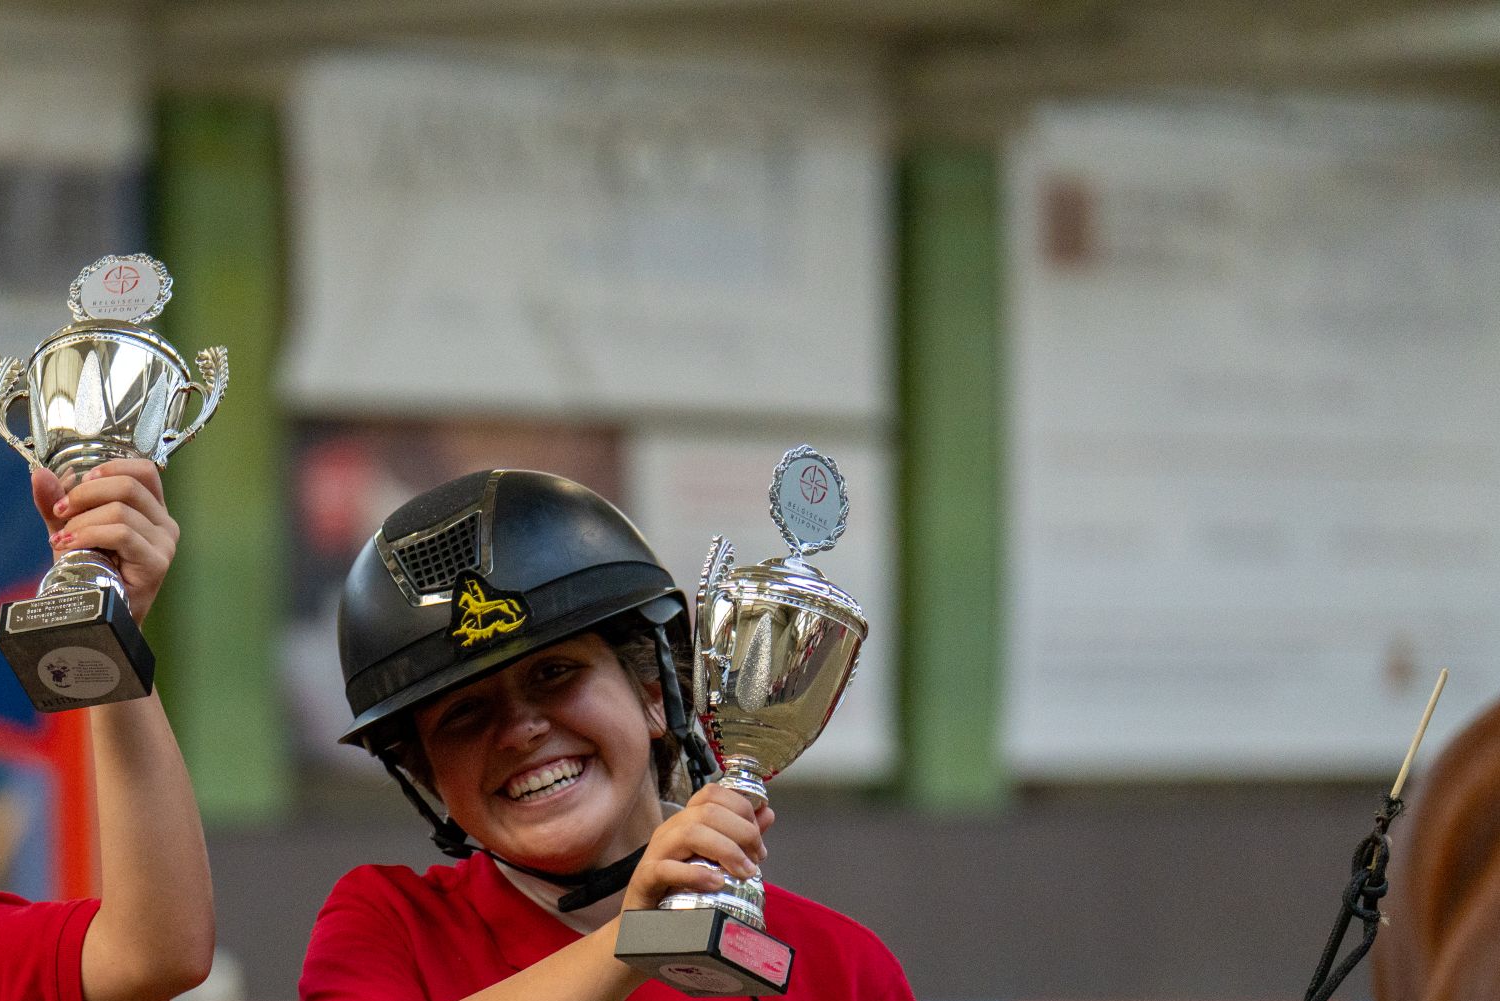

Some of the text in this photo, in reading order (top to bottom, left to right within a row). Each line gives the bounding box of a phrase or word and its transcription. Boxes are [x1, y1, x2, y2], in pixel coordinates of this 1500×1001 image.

[92, 298, 146, 306] BELGISCHE
[98, 306, 138, 314] RIJPONY
[787, 501, 828, 525] BELGISCHE
[790, 513, 822, 533] RIJPONY
